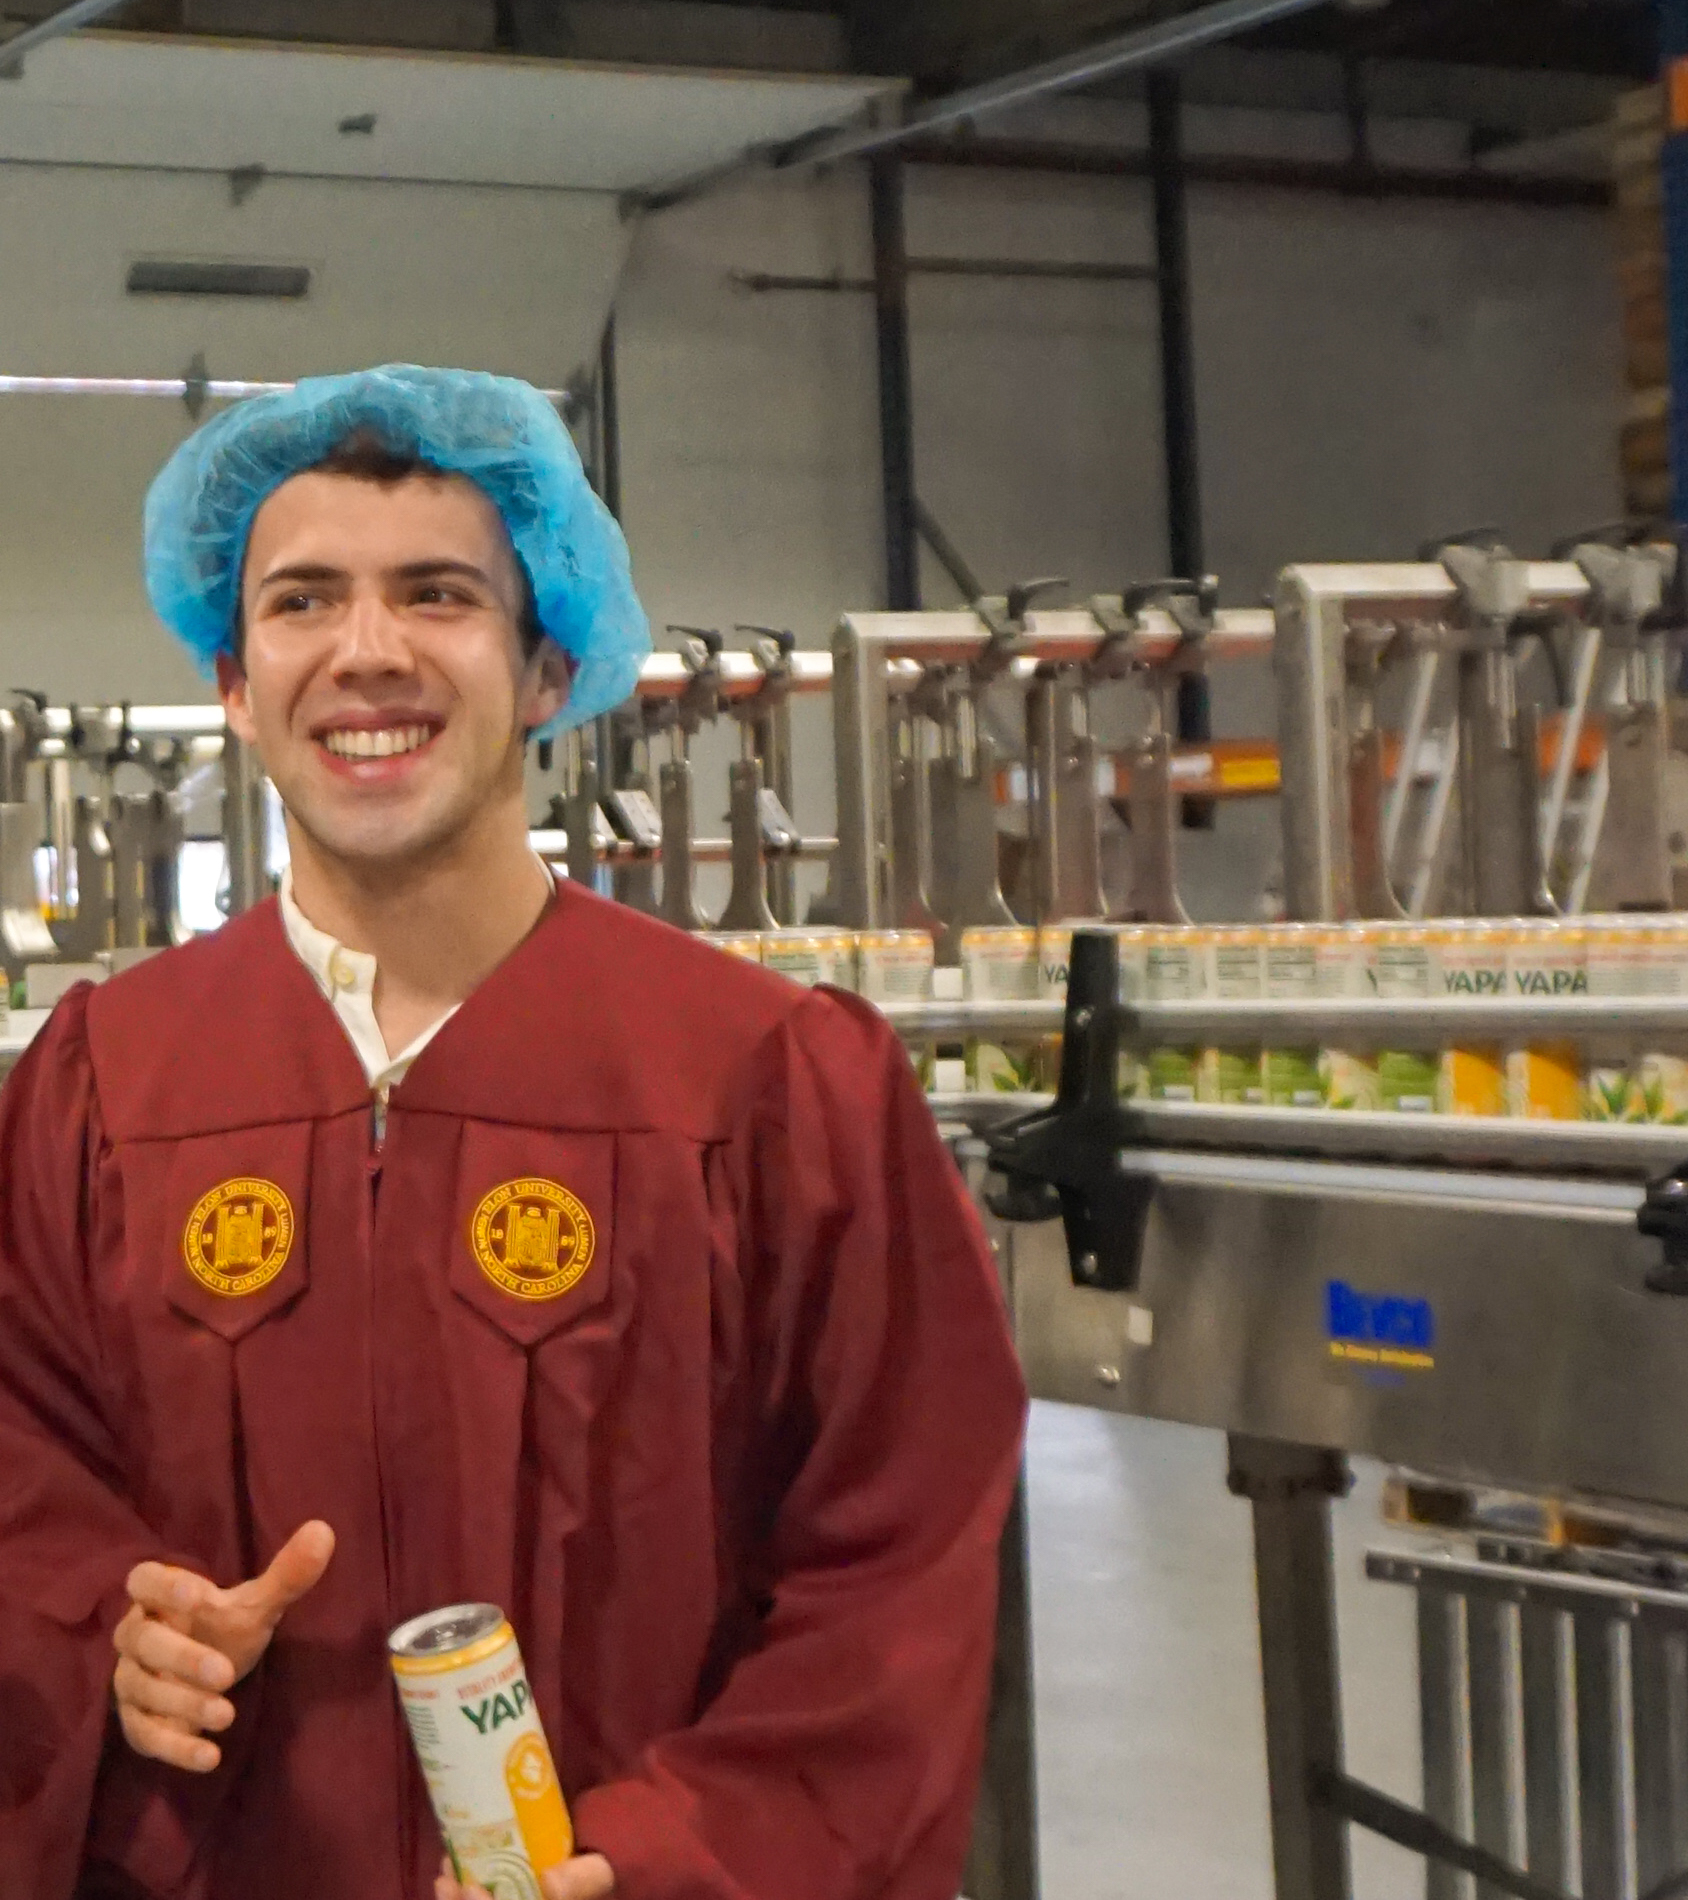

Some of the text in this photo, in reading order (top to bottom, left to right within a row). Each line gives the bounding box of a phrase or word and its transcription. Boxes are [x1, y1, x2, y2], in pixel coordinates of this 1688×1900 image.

[1044, 964, 1069, 984] YA
[1515, 969, 1588, 994] YAPA
[224, 1181, 286, 1214] UNIVERSITY
[514, 1182, 588, 1223] UNIVERSITY
[520, 1263, 584, 1294] CAROLINA
[459, 1679, 530, 1735] YAP
